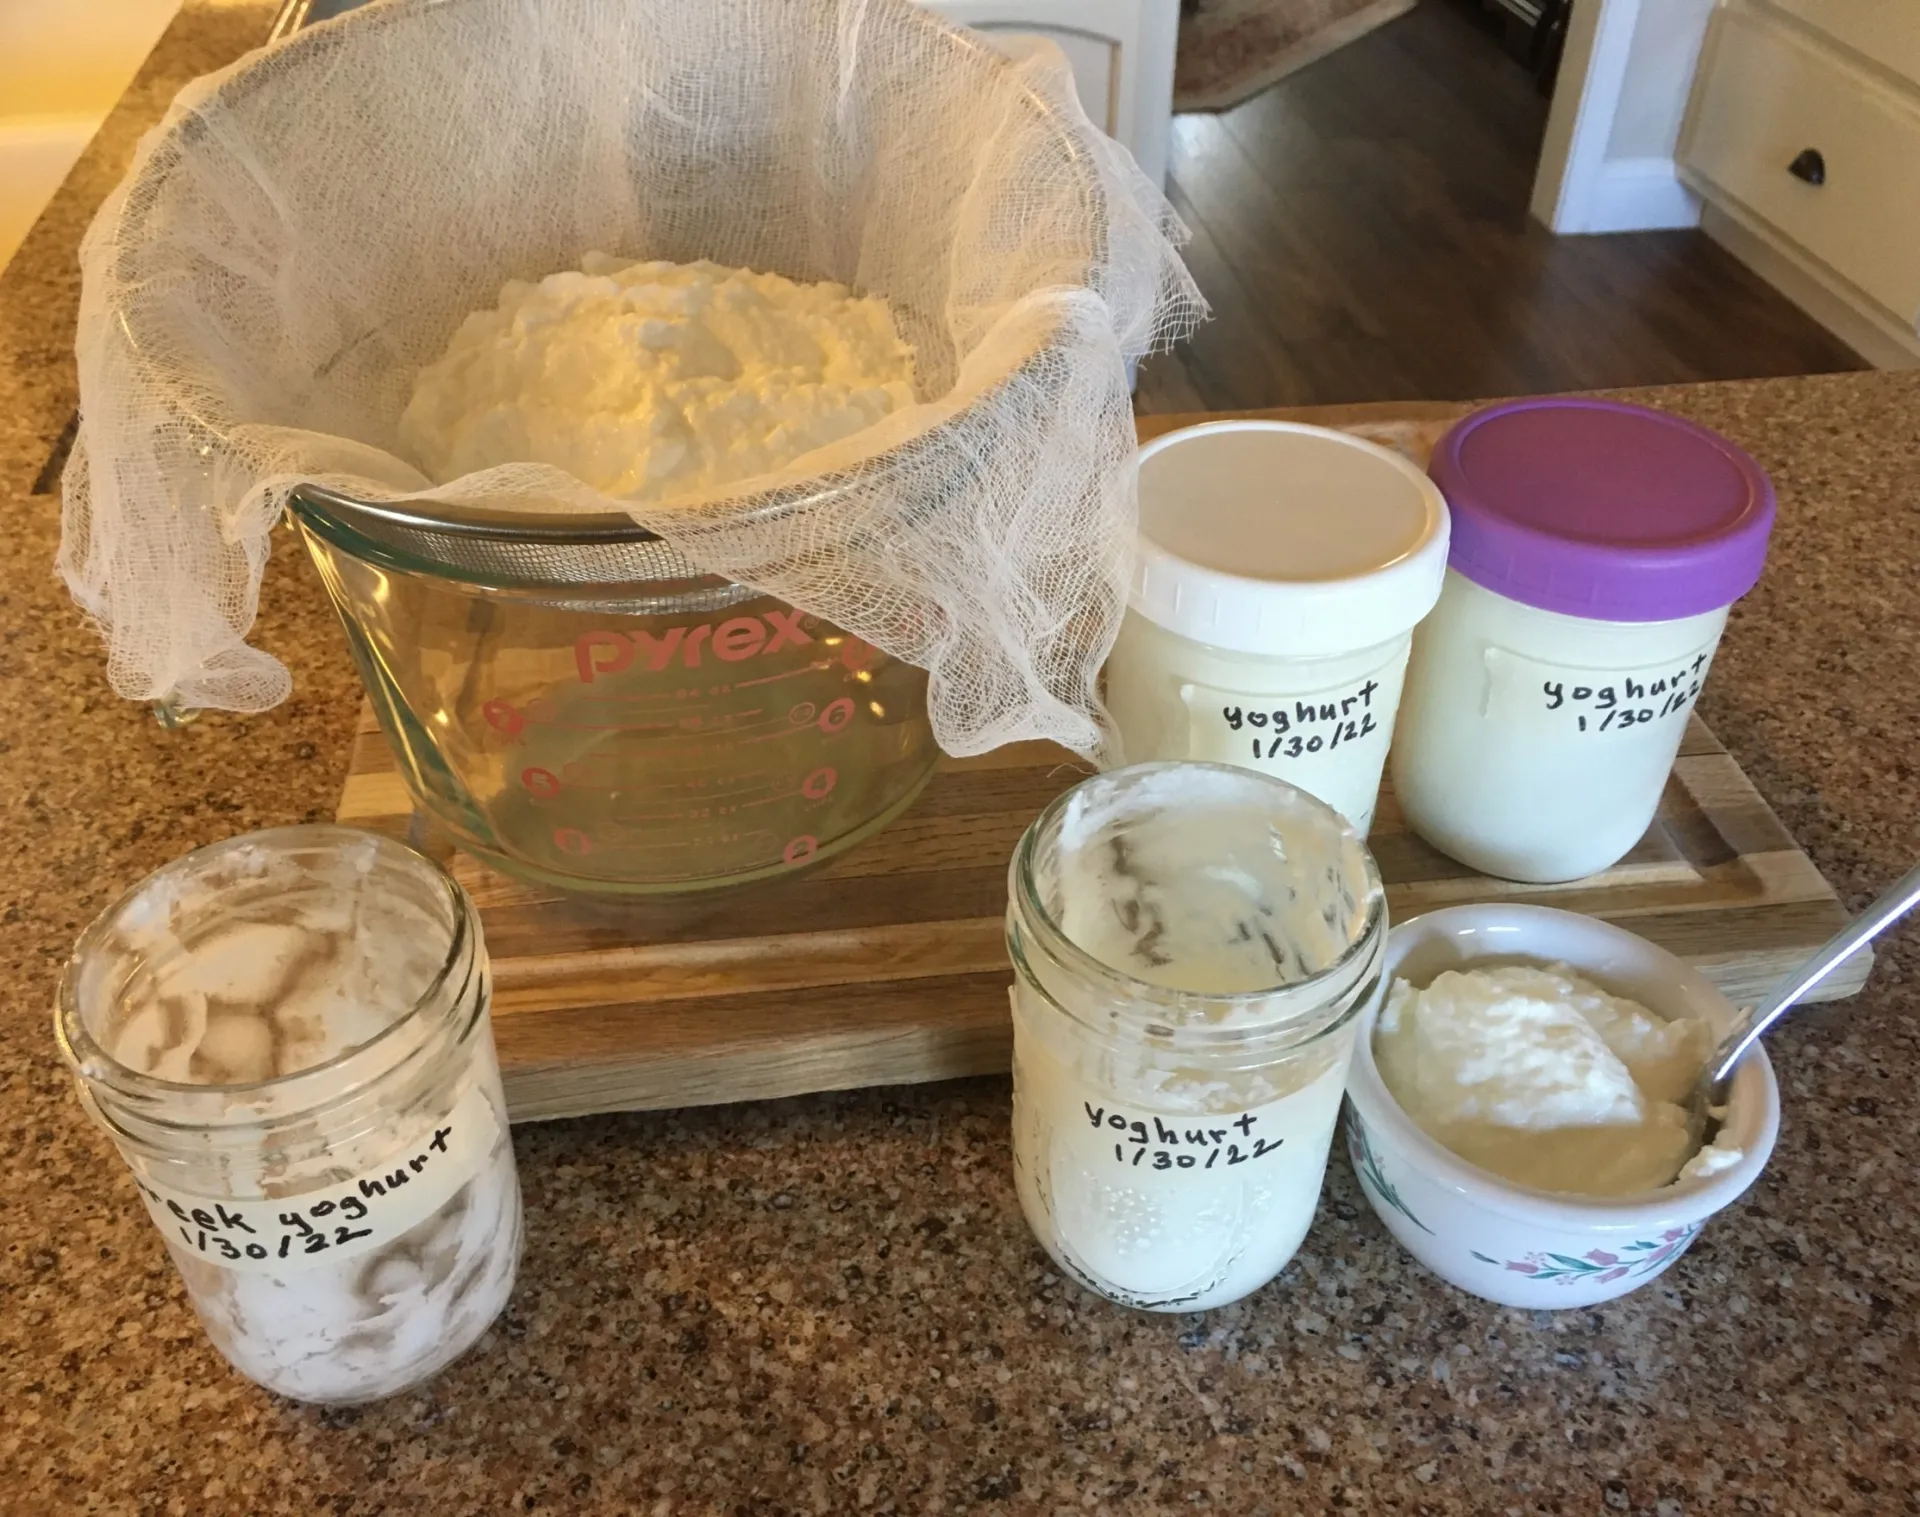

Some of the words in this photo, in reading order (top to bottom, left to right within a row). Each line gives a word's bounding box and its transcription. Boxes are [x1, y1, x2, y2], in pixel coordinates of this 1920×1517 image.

[573, 608, 814, 684] pyrex
[1222, 679, 1379, 735] yoghurt
[1542, 652, 1708, 710] yoghurt
[1577, 679, 1700, 732] 1/30/22
[1252, 711, 1378, 760] 1/30/22
[279, 1125, 453, 1238] yoghurt
[1114, 1138, 1285, 1171] 1/30/22
[179, 1225, 374, 1260] 1/30/22
